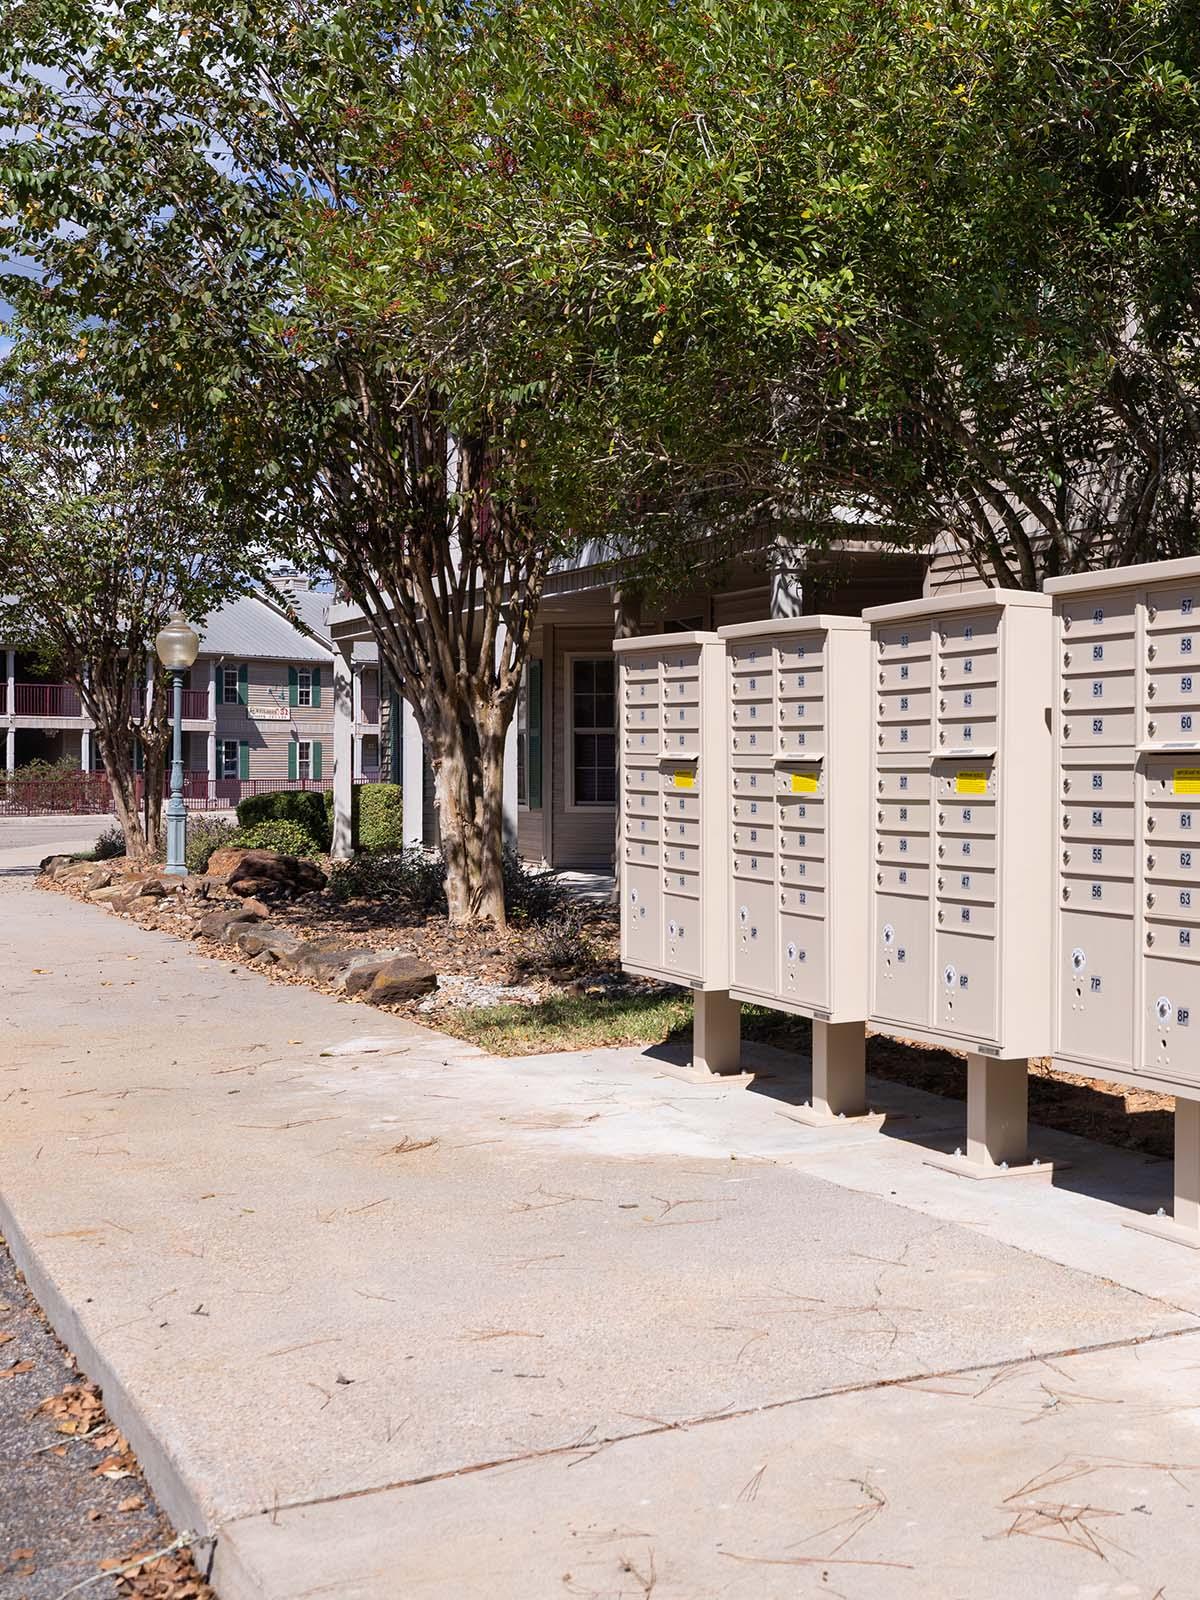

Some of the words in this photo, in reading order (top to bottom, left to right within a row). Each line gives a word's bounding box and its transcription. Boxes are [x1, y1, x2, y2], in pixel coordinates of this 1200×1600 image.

[1182, 599, 1192, 612] 57
[1094, 610, 1103, 622] 49
[965, 628, 972, 638] 41
[1181, 638, 1192, 651] 58
[1093, 647, 1103, 658] 50
[901, 666, 908, 677] 34
[964, 661, 972, 672] 42
[1093, 683, 1103, 695] 51
[1181, 678, 1192, 690] 59
[901, 698, 908, 709] 35
[964, 694, 972, 704] 43
[1093, 720, 1103, 732] 52
[1181, 716, 1192, 729] 60
[963, 728, 972, 738] 44
[900, 777, 907, 787] 37
[1093, 775, 1103, 787] 53
[900, 809, 907, 819] 38
[963, 810, 971, 821] 45
[1092, 812, 1102, 824] 54
[1181, 814, 1191, 827] 61
[900, 840, 907, 850] 39
[1092, 848, 1102, 860] 55
[1180, 853, 1191, 866] 62
[899, 872, 907, 882] 40
[962, 876, 970, 887] 47
[1092, 886, 1102, 897] 56
[1180, 892, 1191, 905] 63
[962, 910, 970, 920] 48
[1179, 931, 1190, 944] 64
[898, 950, 906, 960] 5P
[960, 976, 968, 986] 6P
[1091, 978, 1101, 990] 7P
[1177, 1009, 1189, 1022] 8P
